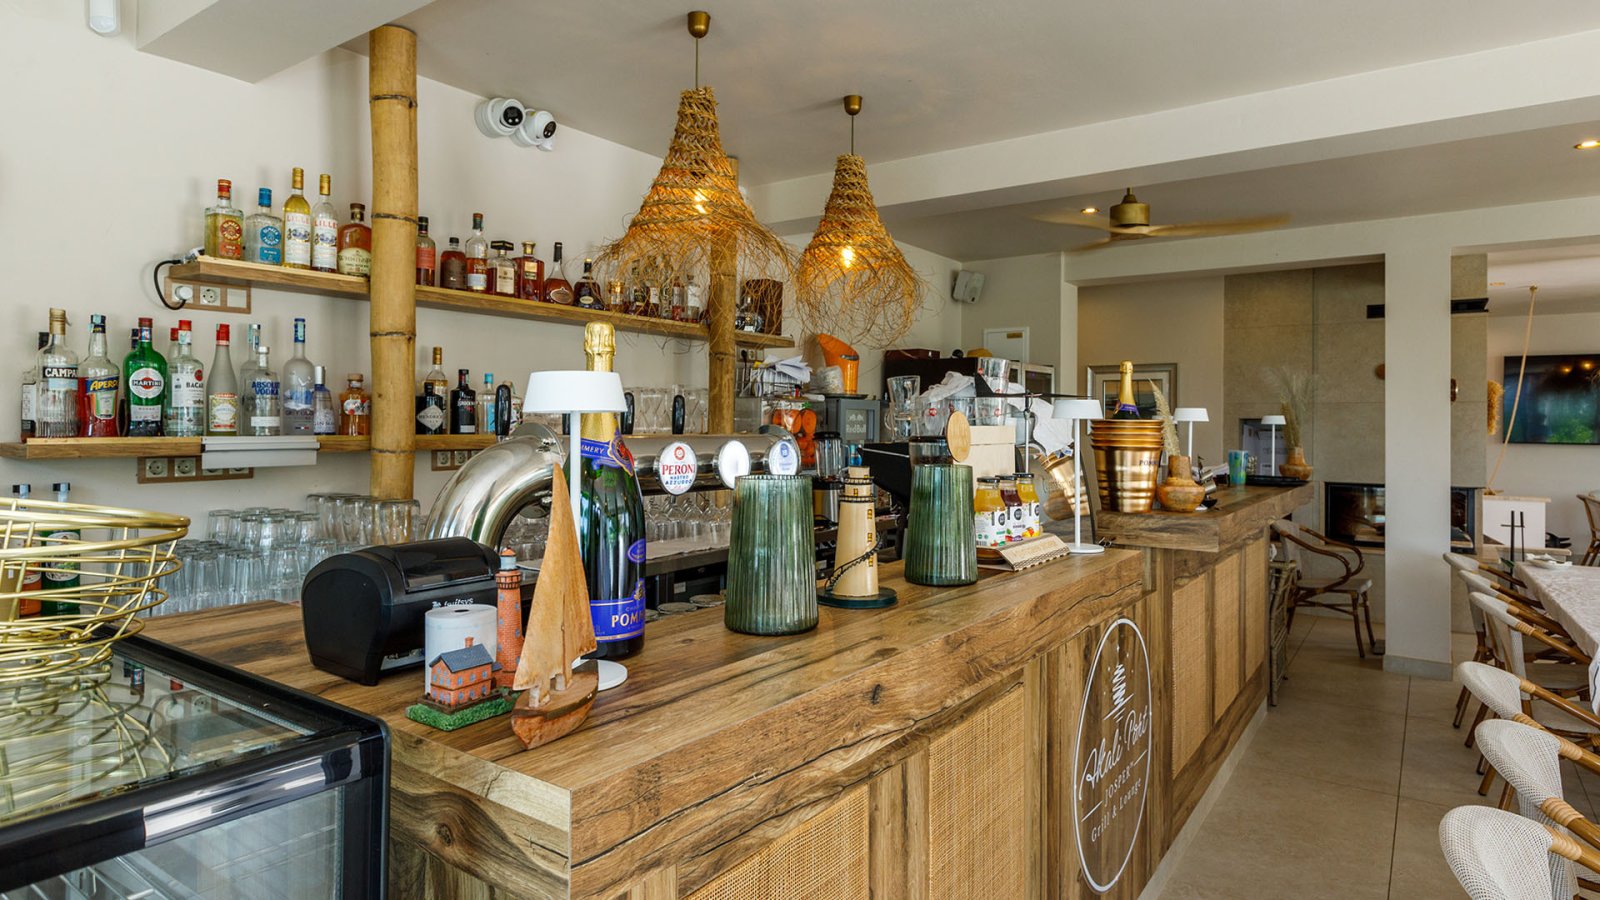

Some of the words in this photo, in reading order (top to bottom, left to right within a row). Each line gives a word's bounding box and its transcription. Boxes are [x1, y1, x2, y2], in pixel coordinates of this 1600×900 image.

[132, 379, 162, 387] MARTINI
[255, 387, 279, 395] VODKA
[661, 464, 696, 475] PERONI
[1091, 812, 1110, 843] Grill
[1119, 777, 1142, 810] Lounge
